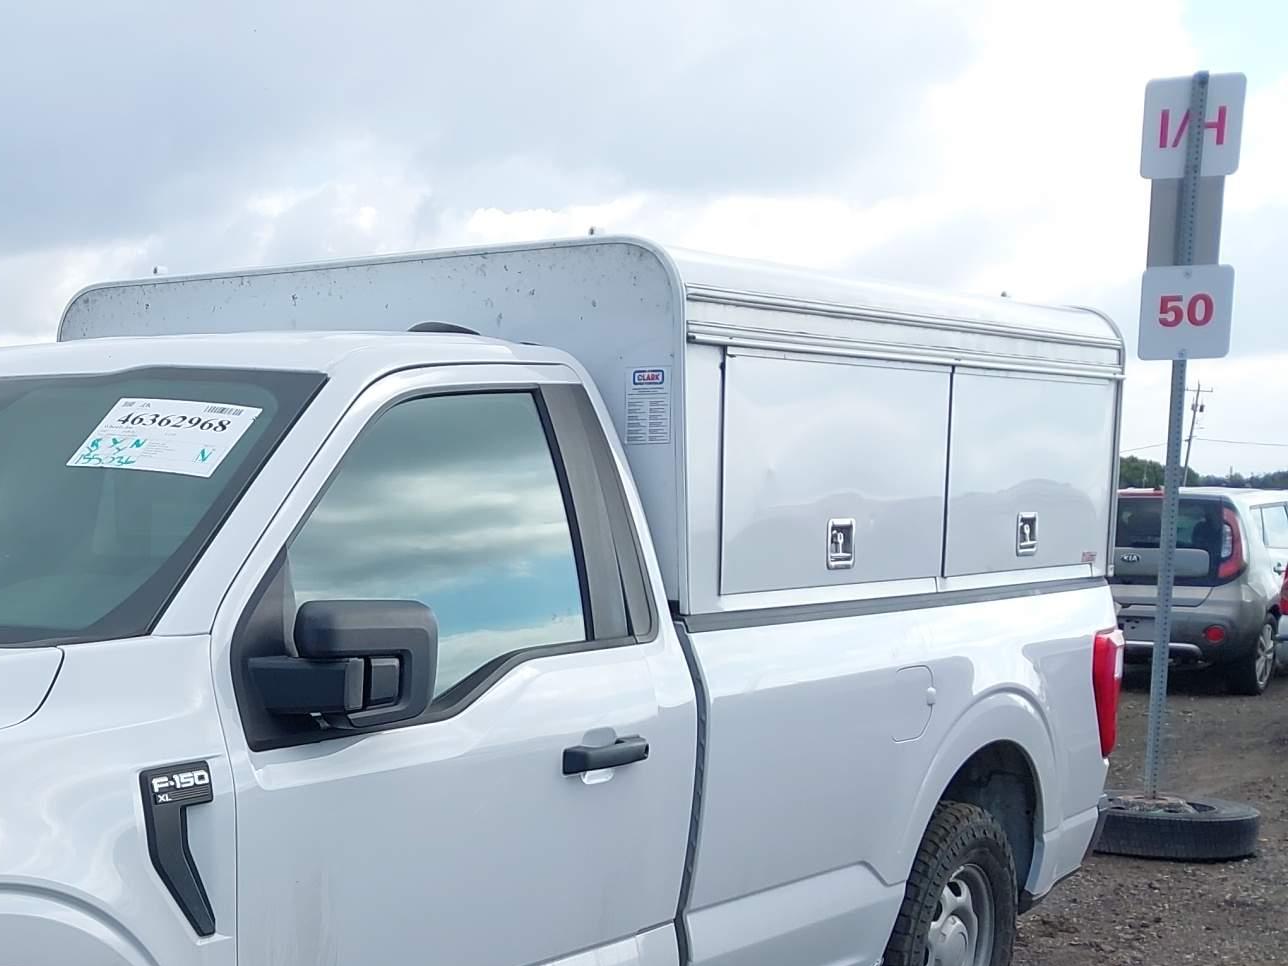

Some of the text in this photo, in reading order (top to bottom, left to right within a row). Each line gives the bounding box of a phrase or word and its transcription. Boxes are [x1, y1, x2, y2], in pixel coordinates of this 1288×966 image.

[1158, 293, 1214, 328] 50
[637, 373, 661, 381] CLARK
[118, 411, 231, 432] 46362968
[151, 769, 210, 793] F-150
[158, 793, 173, 803] XL
